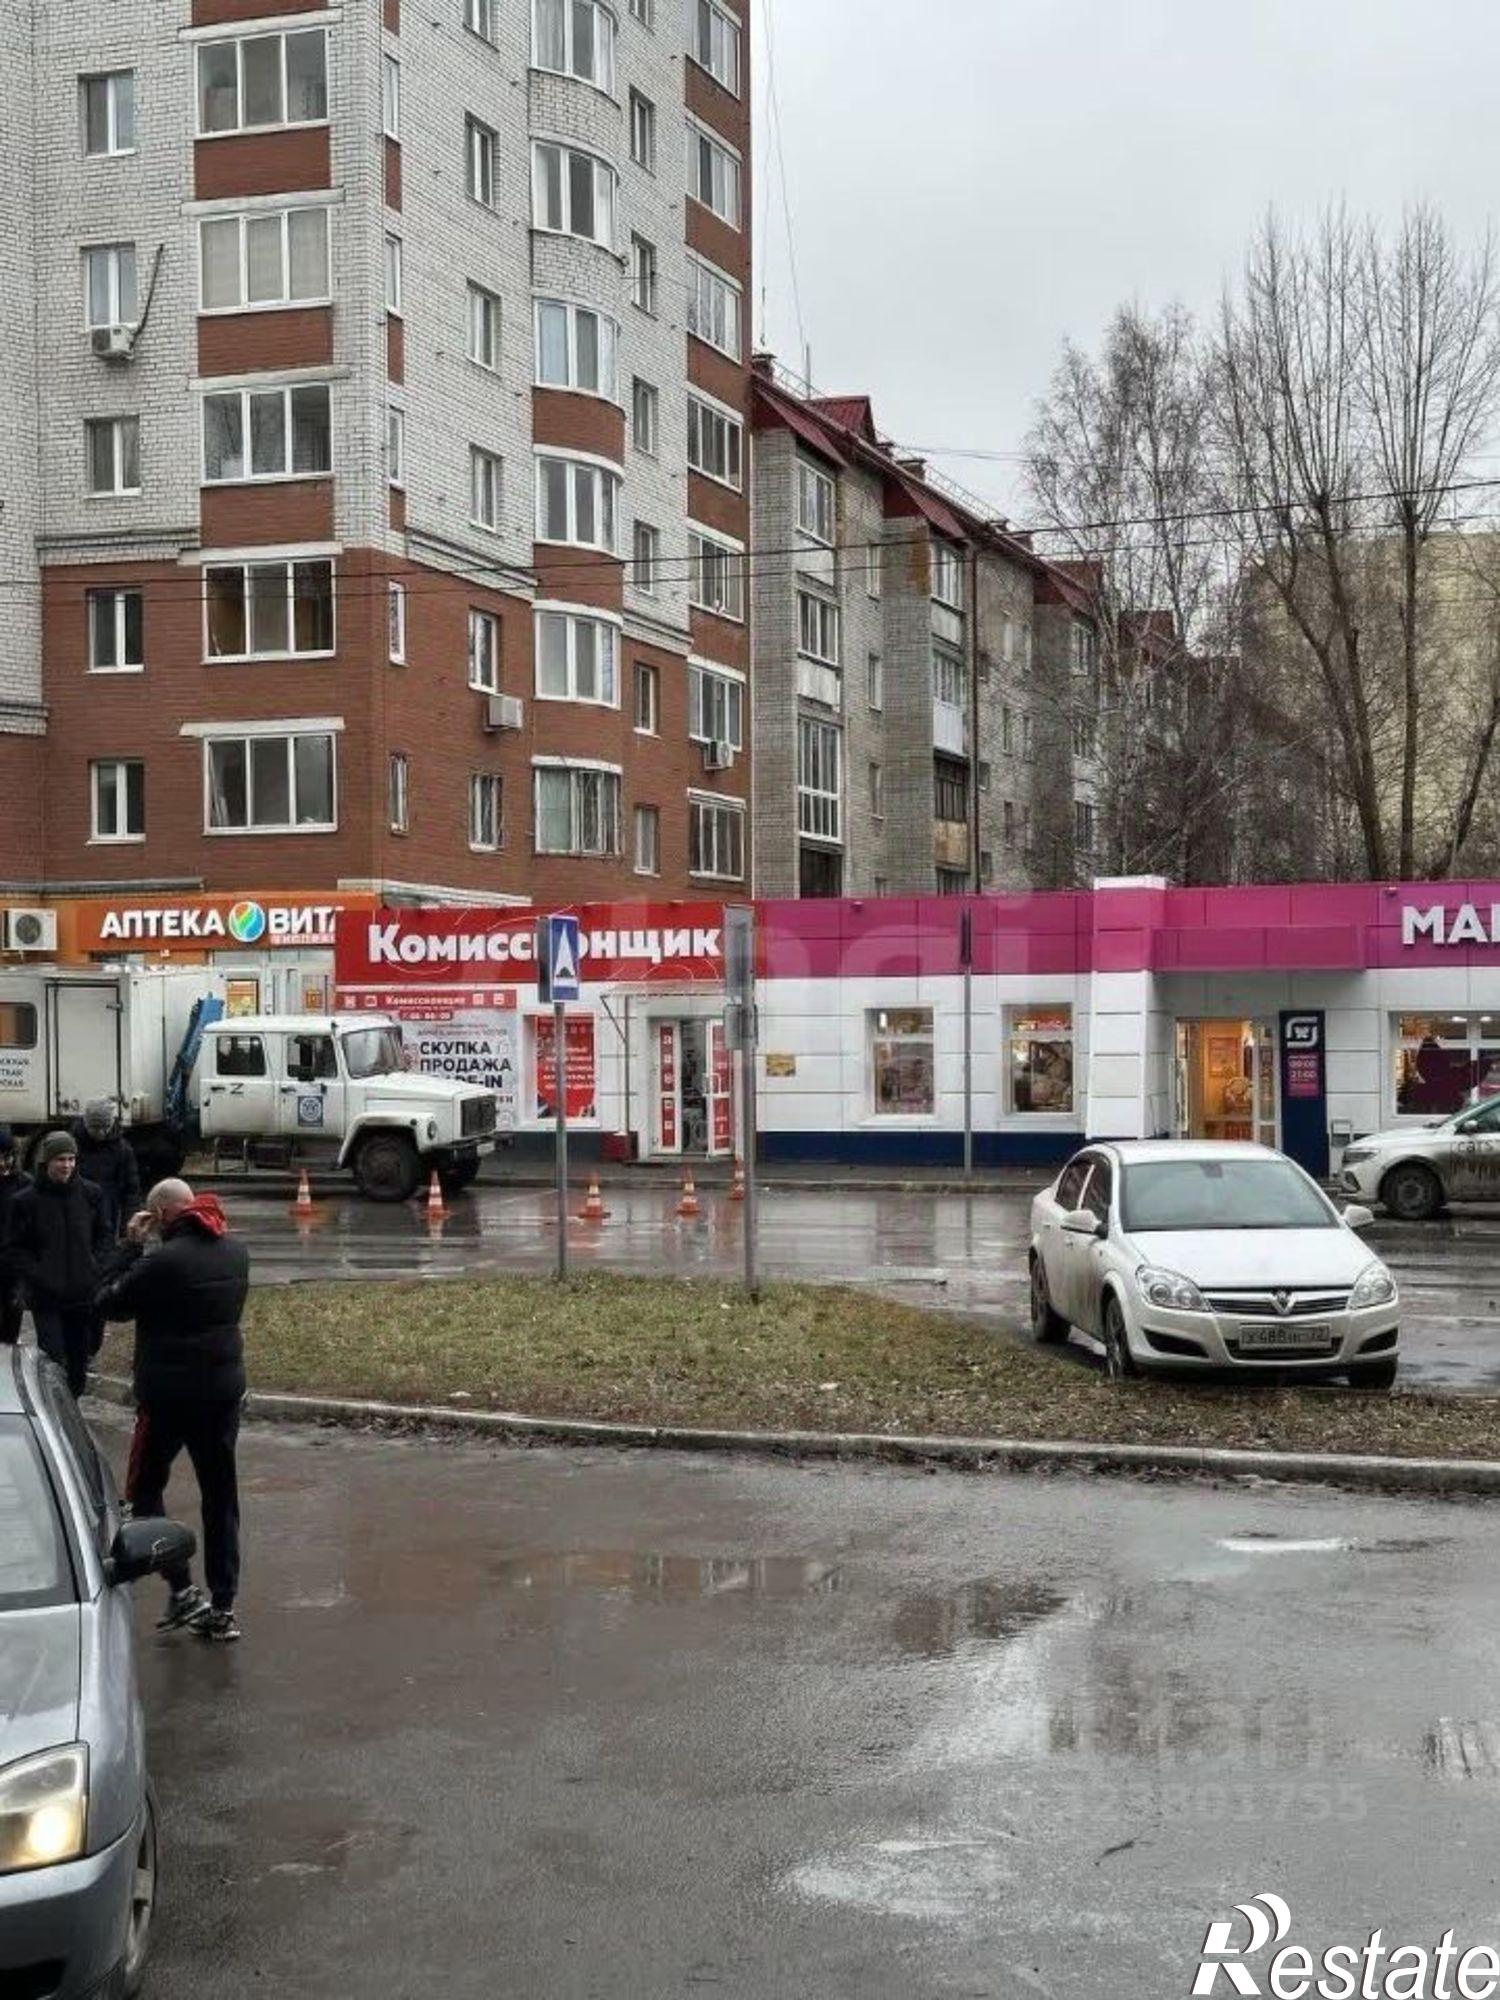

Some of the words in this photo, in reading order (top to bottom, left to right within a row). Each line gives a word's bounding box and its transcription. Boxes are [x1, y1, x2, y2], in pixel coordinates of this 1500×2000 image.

[100, 909, 226, 938] АПТЕКА
[368, 924, 721, 963] Комисснщик
[420, 1041, 492, 1055] СКУПКА
[420, 1058, 512, 1072] ПРОДАЖА
